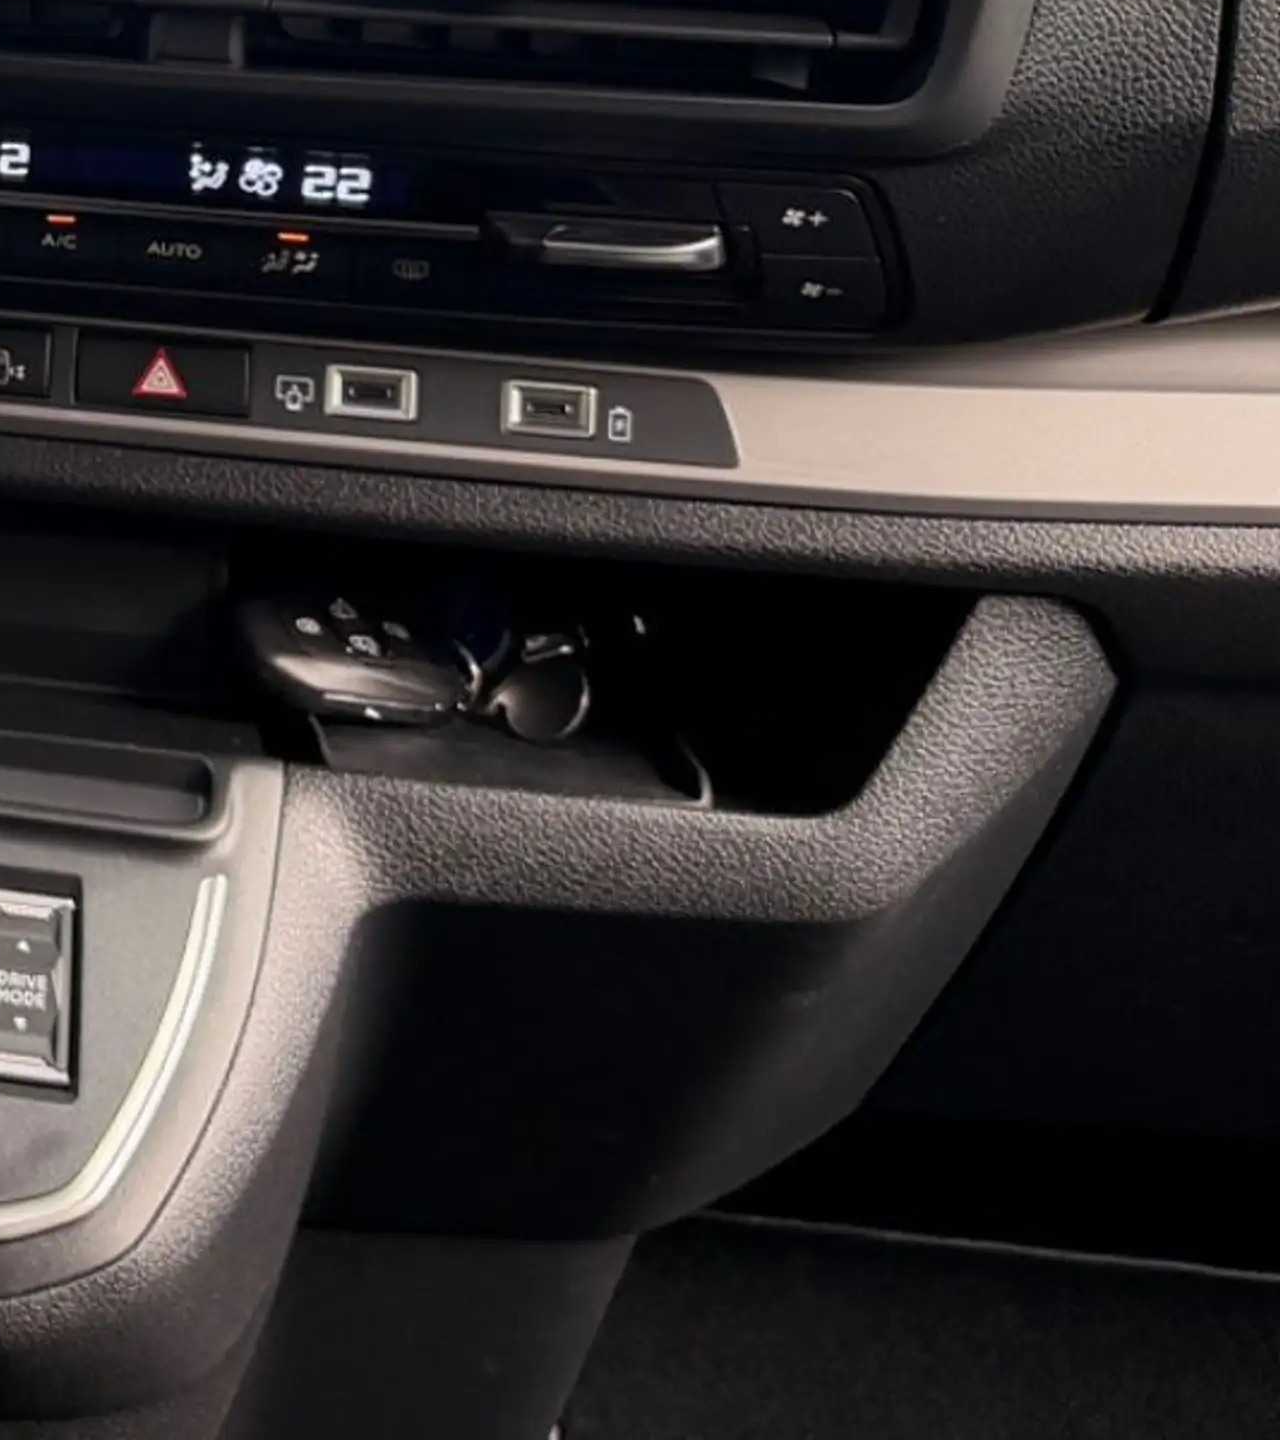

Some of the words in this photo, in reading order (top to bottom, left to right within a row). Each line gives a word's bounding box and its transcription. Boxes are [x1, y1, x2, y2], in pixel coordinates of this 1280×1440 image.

[301, 164, 373, 203] 22
[41, 232, 77, 251] A/C
[146, 240, 203, 262] AUTO
